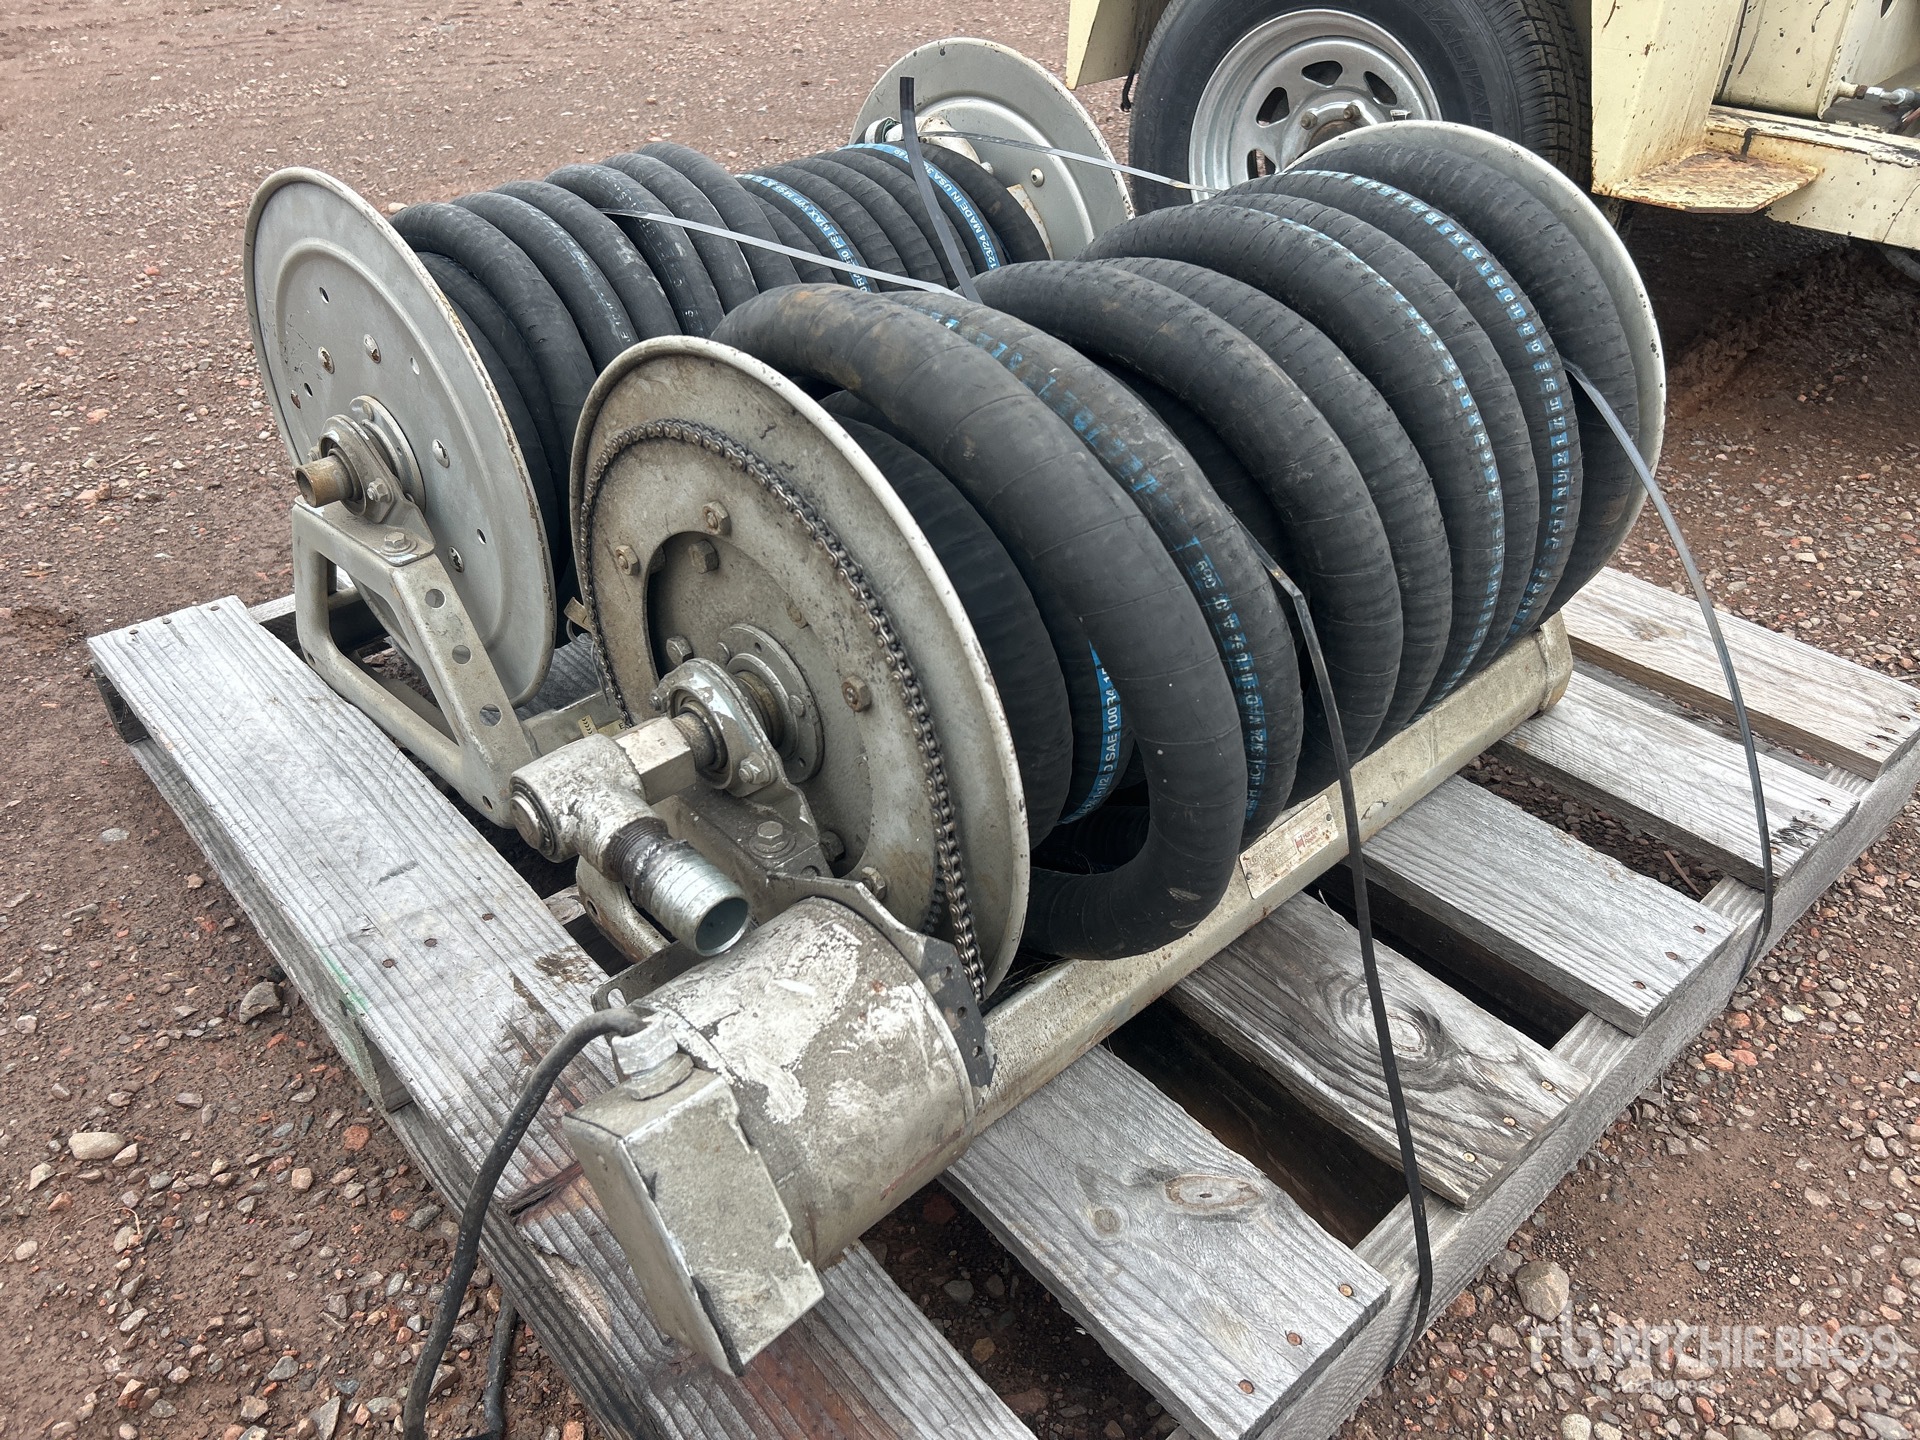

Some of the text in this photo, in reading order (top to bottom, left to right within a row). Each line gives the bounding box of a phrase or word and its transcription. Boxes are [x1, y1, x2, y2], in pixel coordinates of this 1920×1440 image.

[933, 171, 954, 192] USA
[793, 196, 811, 211] WP
[950, 192, 963, 204] IN
[808, 208, 832, 231] MAX
[959, 202, 983, 234] MADE
[830, 230, 846, 249] PSI
[1105, 733, 1118, 761] SAE
